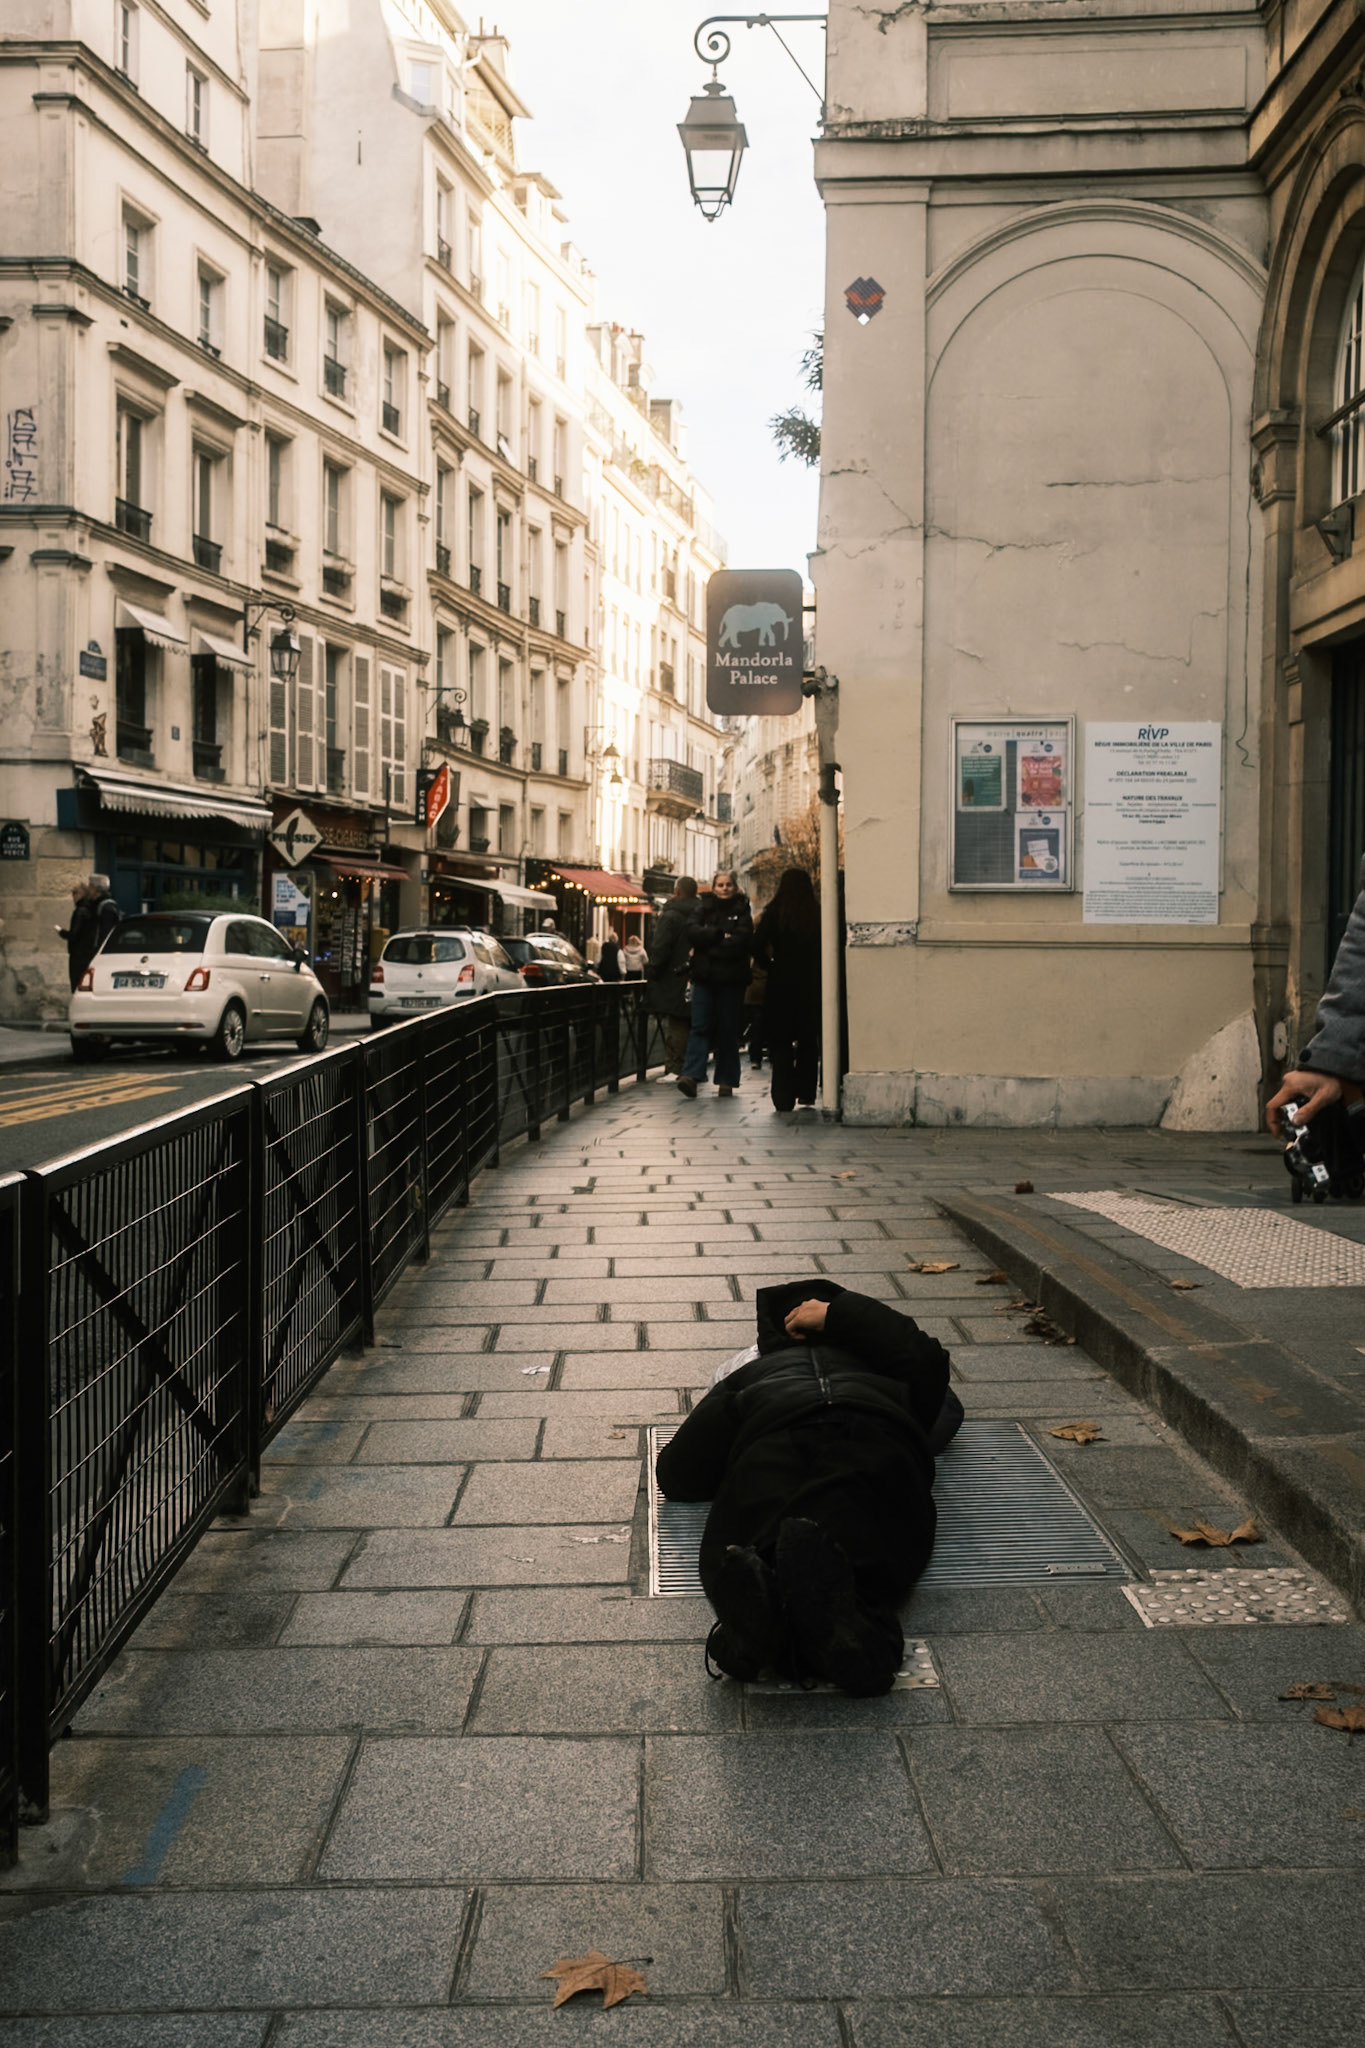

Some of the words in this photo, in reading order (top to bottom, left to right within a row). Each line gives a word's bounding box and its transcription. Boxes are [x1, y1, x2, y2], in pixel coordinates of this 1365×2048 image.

[715, 652, 792, 666] Mandorla
[730, 668, 778, 684] Palace
[429, 775, 447, 819] TABAC
[418, 790, 426, 821] CASH
[272, 833, 317, 844] PRSSE
